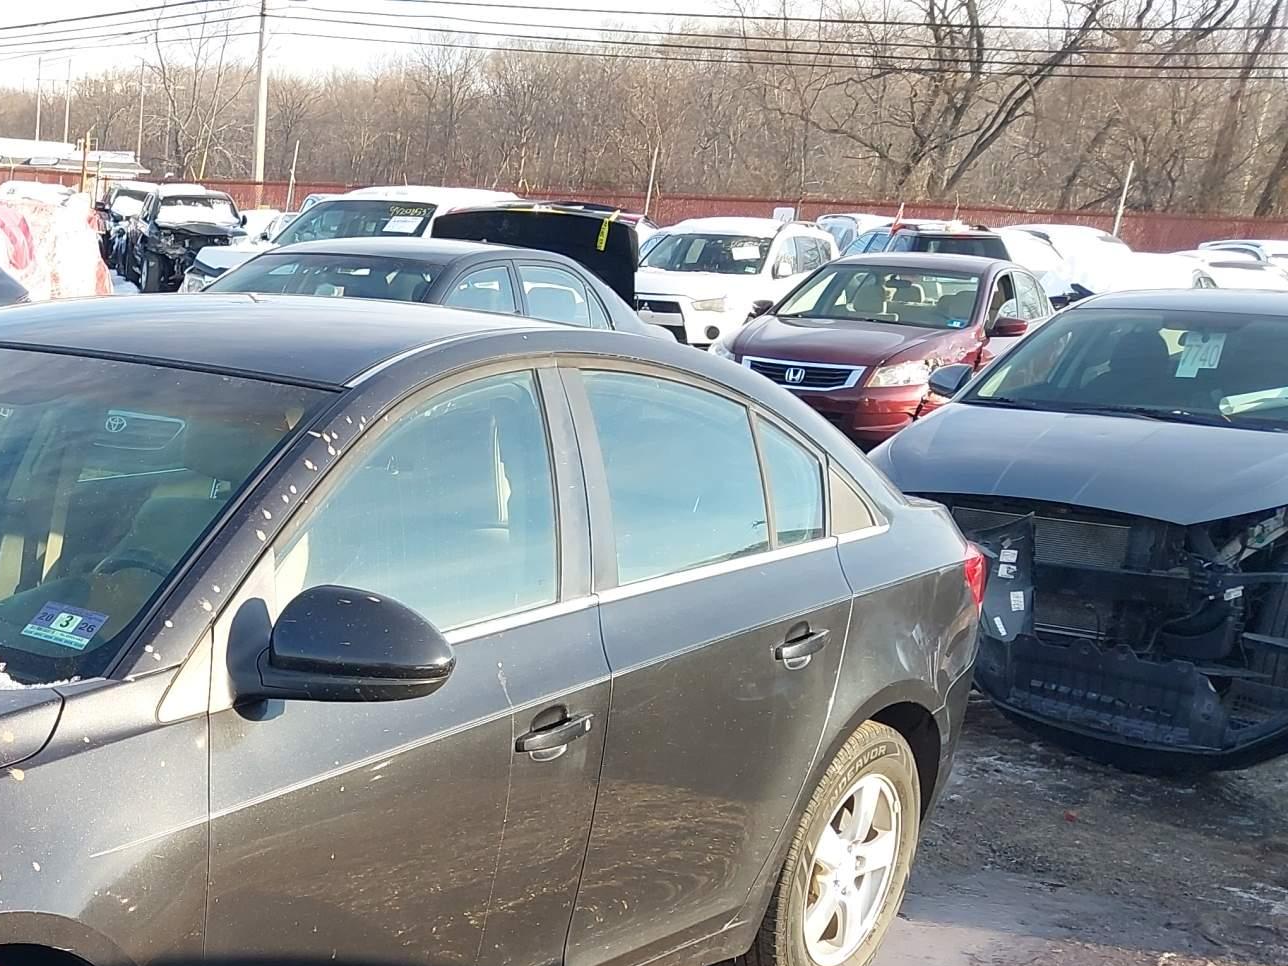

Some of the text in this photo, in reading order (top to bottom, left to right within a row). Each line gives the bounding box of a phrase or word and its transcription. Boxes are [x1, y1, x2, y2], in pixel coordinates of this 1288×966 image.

[1181, 343, 1220, 367] 7740
[38, 612, 54, 622] 20
[59, 614, 74, 628] 3
[78, 622, 97, 633] 26
